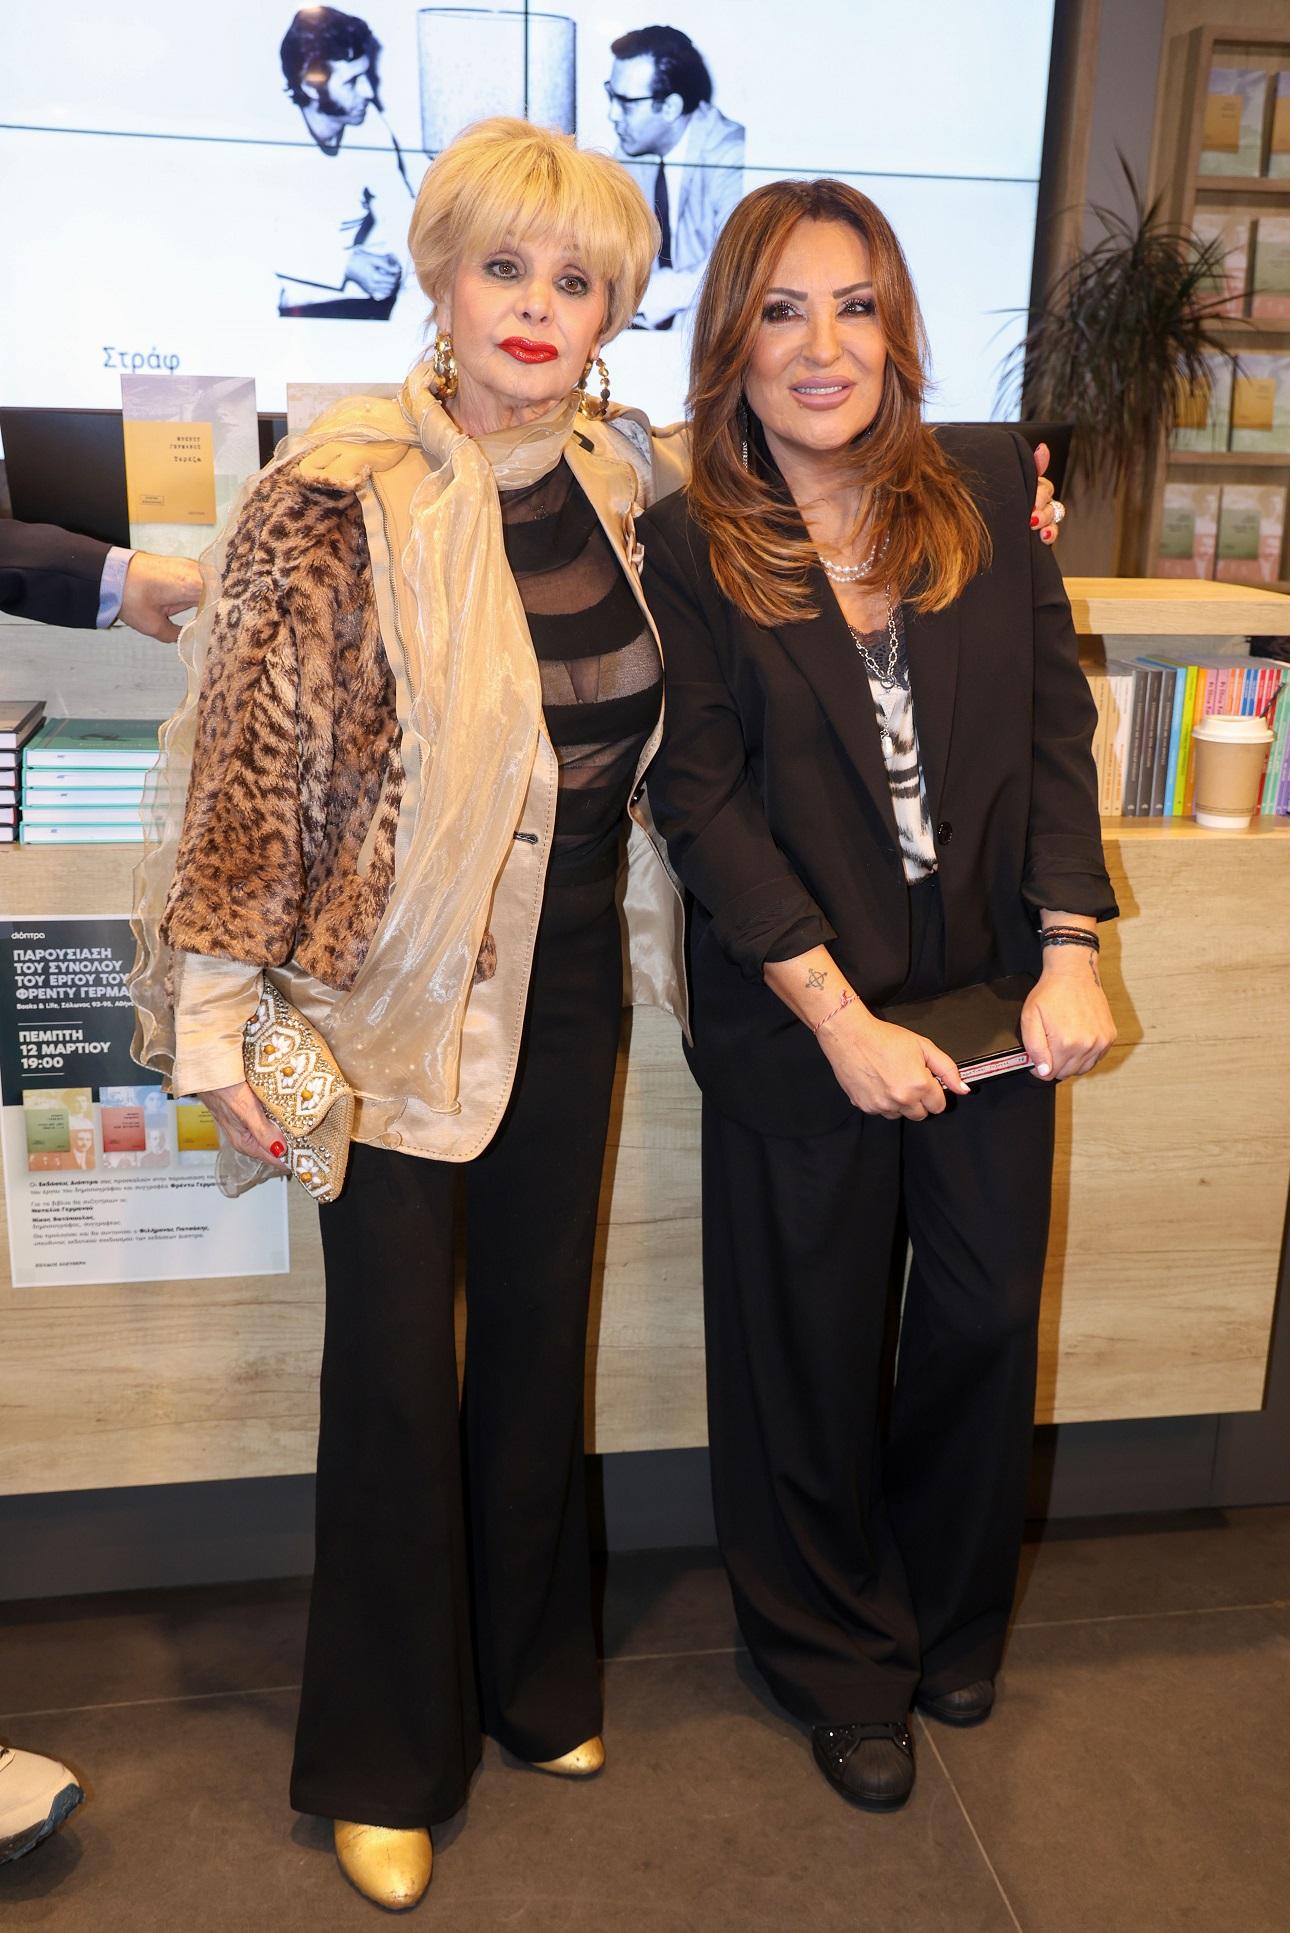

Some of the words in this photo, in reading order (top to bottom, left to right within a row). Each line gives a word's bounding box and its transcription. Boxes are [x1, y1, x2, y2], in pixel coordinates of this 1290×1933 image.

[103, 346, 180, 376] Στράφ
[13, 948, 112, 961] ΠΑΡΟΥΣΙΑΣΗ
[14, 962, 45, 974] ΤΟΥ
[48, 960, 123, 973] ΣΥΝΟΛΟΥ
[14, 975, 46, 987] ΤΟΥ
[49, 974, 97, 986] ΕΡΓΟΥ
[100, 973, 130, 985] ΤΟΥ
[16, 987, 77, 1000] ΦΡΕΝΤΥ
[80, 986, 131, 998] ΓΕΡΜΑ
[18, 1029, 84, 1043] ΠΕΜΠΤΗ
[20, 1044, 38, 1056] 12
[41, 1041, 112, 1055] ΜΑΡΤΙΟΥ
[21, 1056, 64, 1069] 19:00
